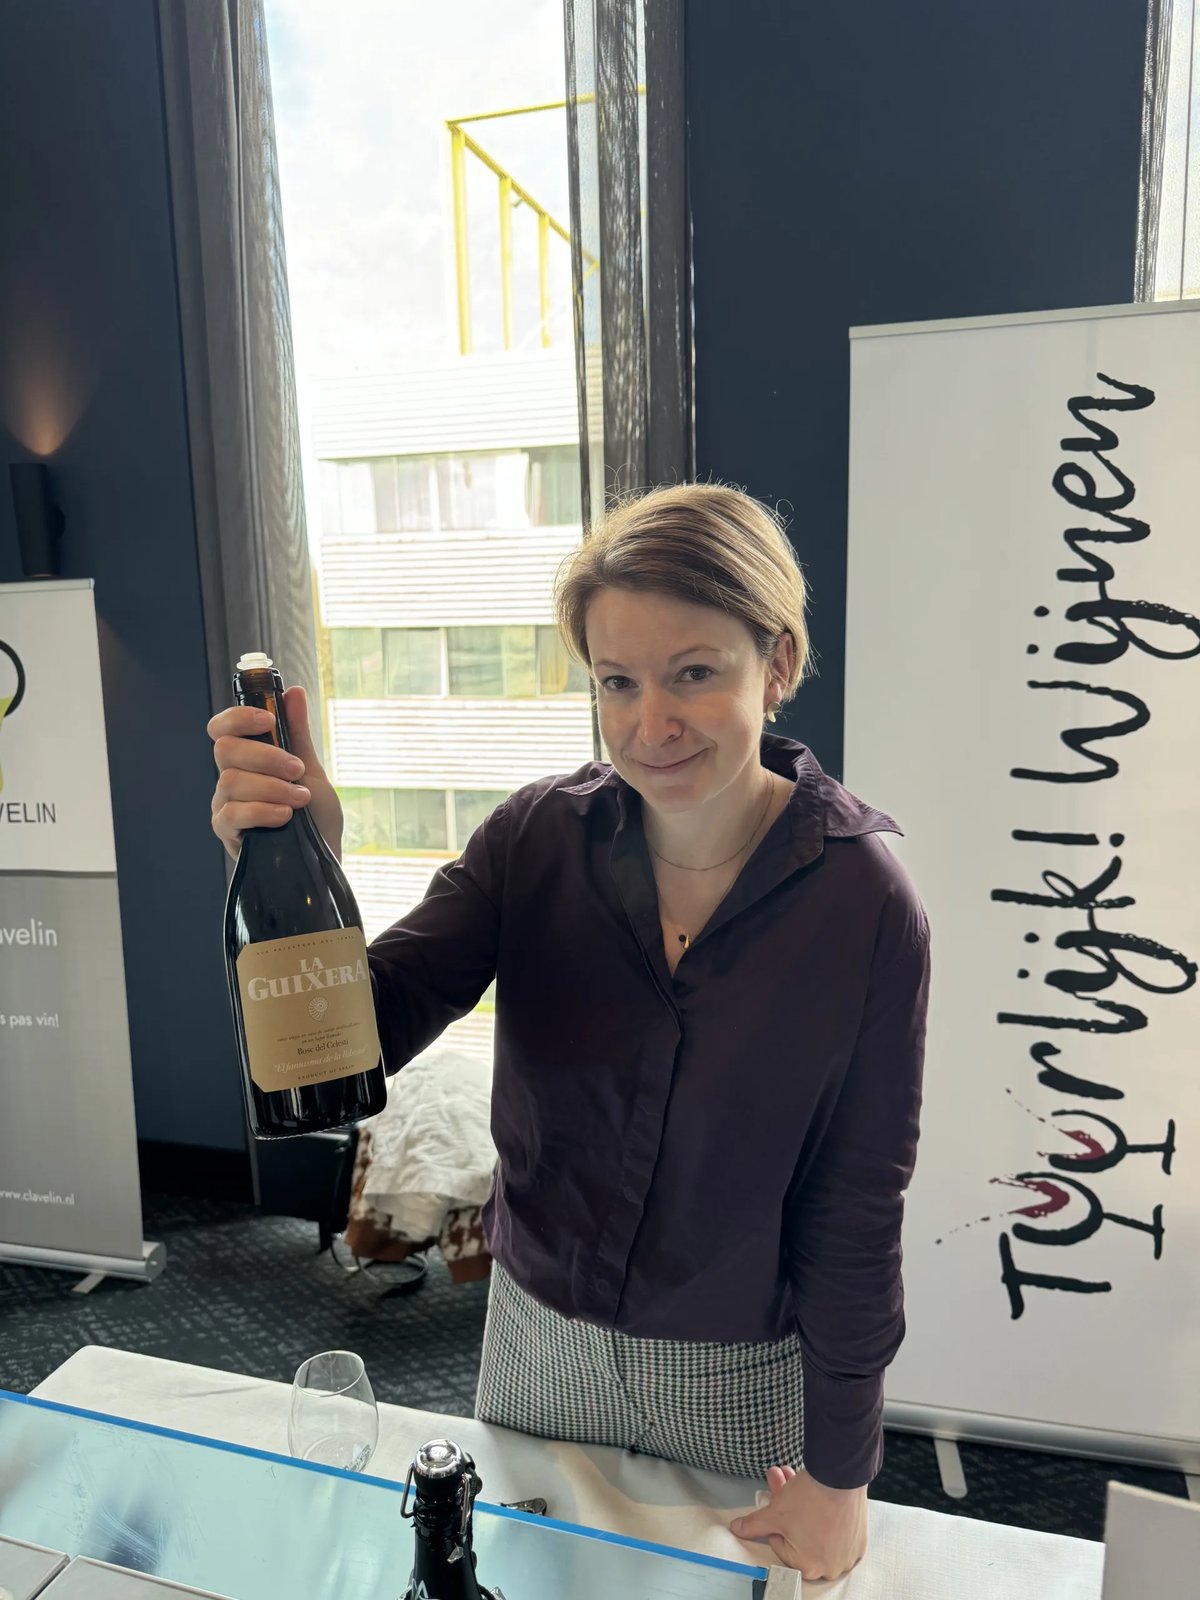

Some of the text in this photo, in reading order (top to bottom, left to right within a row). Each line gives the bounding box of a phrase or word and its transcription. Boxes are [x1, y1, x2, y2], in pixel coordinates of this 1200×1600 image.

[1010, 371, 1200, 784] Wijnen
[0, 917, 58, 946] velin
[300, 957, 324, 973] LA
[9, 1015, 33, 1029] pas
[36, 1012, 59, 1028] vin!
